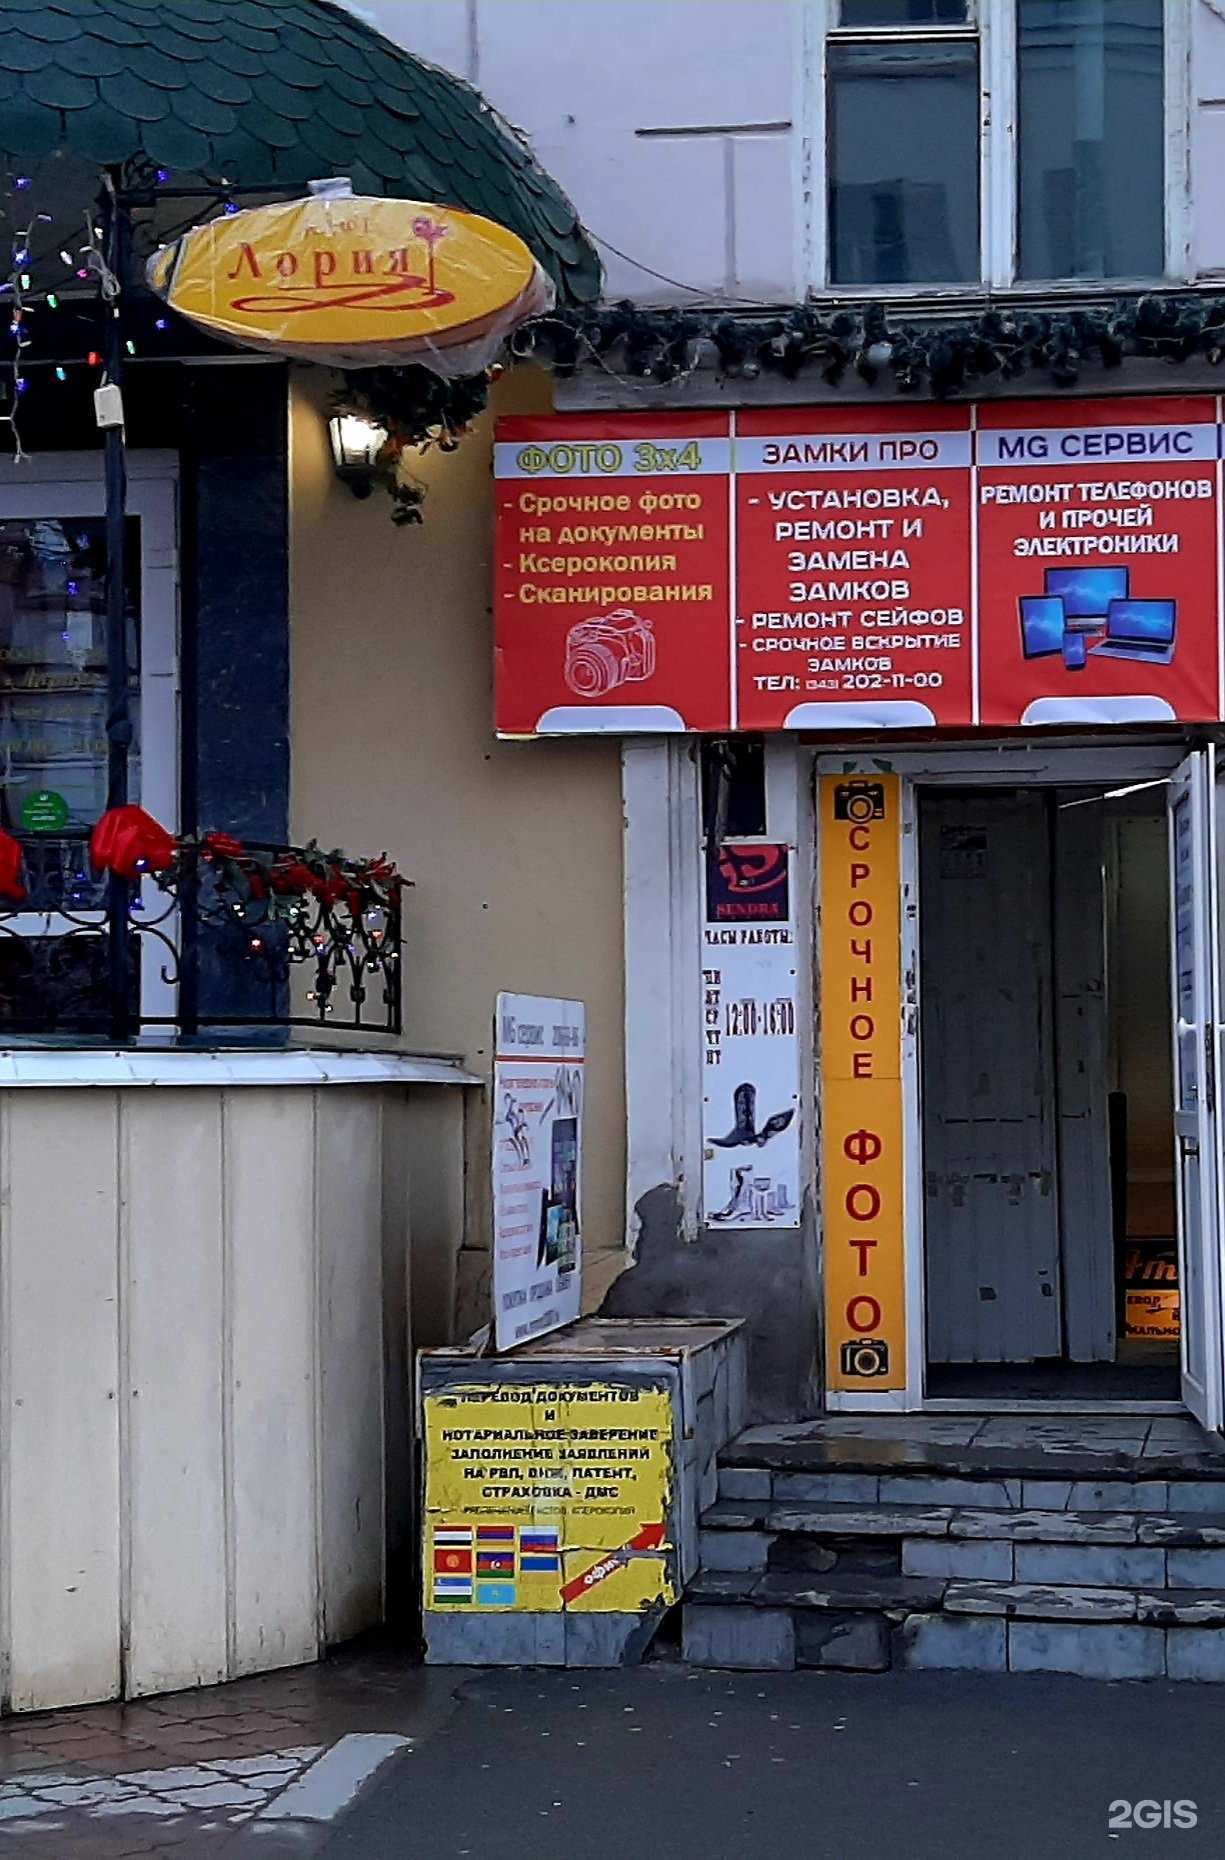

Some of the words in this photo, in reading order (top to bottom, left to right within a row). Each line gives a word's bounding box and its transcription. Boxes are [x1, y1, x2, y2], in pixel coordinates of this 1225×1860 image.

[228, 243, 411, 290] Лория
[762, 441, 868, 465] ЗАМКИ
[879, 439, 939, 461] ПРО
[998, 436, 1049, 460] MG
[1060, 431, 1194, 458] СЕРВИС
[517, 444, 622, 474] ФОТО
[519, 492, 632, 517] Срочное
[638, 490, 702, 515] фото
[767, 486, 950, 511] УСТАНОВКА,
[980, 483, 1074, 505] РЕМОНТ
[1077, 479, 1213, 502] ТЕЛЕФОНОВ
[1039, 510, 1056, 530] И
[1061, 502, 1153, 530] ПРОЧЕЙ
[519, 527, 551, 544] на
[557, 523, 704, 546] документы
[775, 518, 894, 542] РЕМОНТ
[902, 518, 924, 538] И
[1013, 533, 1179, 557] ЭЛЕКТРОНИКИ
[519, 553, 677, 577] Ксерокопия
[787, 549, 911, 572] ЗАМЕНА
[519, 583, 714, 607] Сканирования
[788, 580, 911, 603] ЗАМКОВ
[751, 610, 853, 630] РЕМОНТ
[860, 605, 965, 628] СЕЙФОВ
[752, 636, 846, 652] СРОЧНОЕ
[851, 632, 961, 651] ВСКРЫТИЕ
[807, 656, 893, 673] ЗАМКОВ
[752, 674, 801, 692] ТЕЛ:
[841, 671, 943, 690] 202-11-00
[848, 825, 875, 1079] СРОЧНОЕ
[843, 1129, 883, 1334] ФОТО
[535, 1387, 640, 1403] ДОКУМЕНТОВ
[544, 1409, 556, 1421] И
[442, 1429, 566, 1442] НОТАРИАЛЬНОЕ
[569, 1428, 659, 1441] ЗАВЕРЕНИЕ
[451, 1448, 553, 1460] ЗАПОЛНЕНИЕ
[463, 1467, 485, 1479] НА
[572, 1466, 638, 1481] ПАТЕНТ,
[482, 1485, 573, 1498] СТРАХОВКА
[584, 1485, 619, 1500] ДМС
